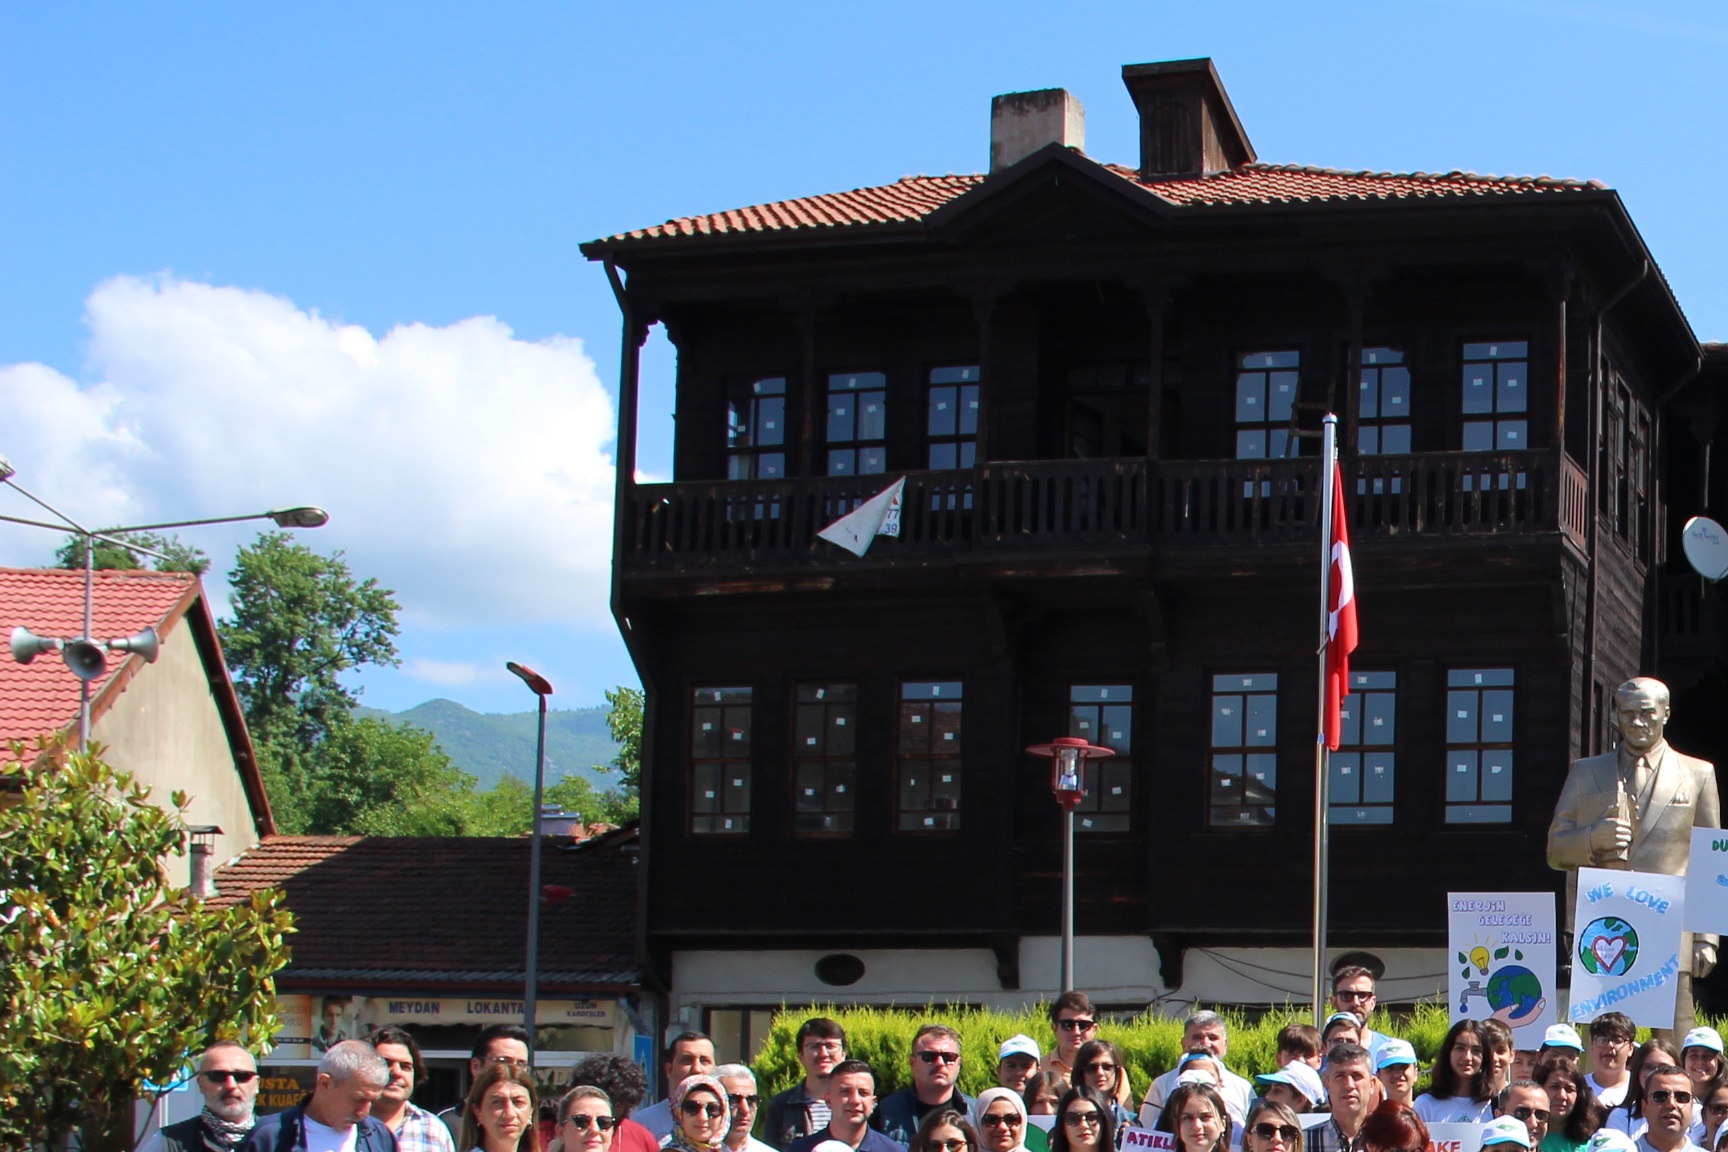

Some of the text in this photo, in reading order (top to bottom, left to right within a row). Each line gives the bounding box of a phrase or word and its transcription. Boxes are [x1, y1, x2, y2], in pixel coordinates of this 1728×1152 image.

[1585, 882, 1670, 914] WE LOVE
[1571, 953, 1679, 1019] ENVIRONMENT
[389, 1001, 525, 1014] MEYDAN LOKANTA
